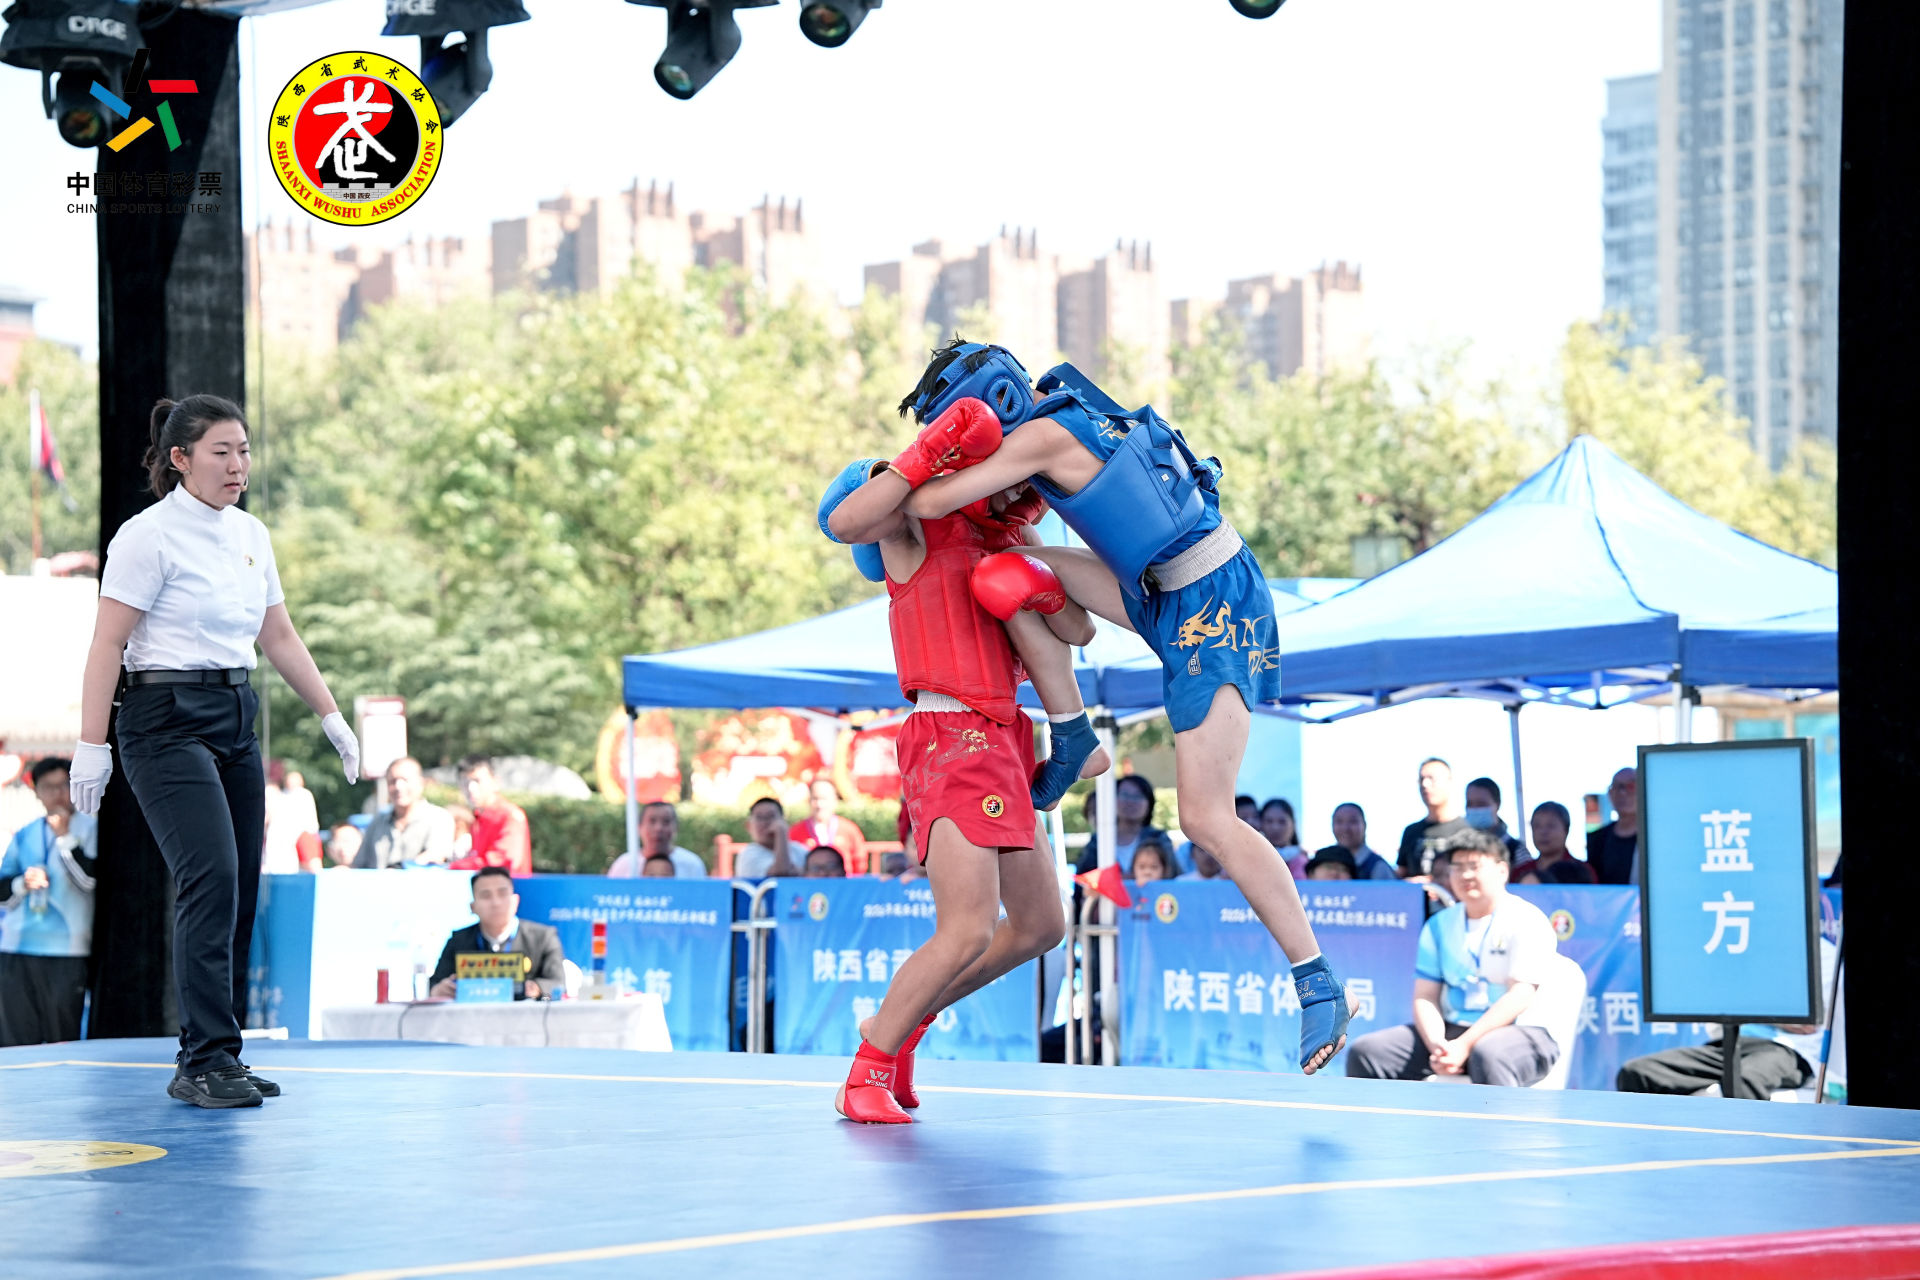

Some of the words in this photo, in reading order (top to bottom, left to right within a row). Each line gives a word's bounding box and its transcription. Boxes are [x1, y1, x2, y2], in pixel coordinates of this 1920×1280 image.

[1700, 809, 1754, 954] 蓝方
[1163, 968, 1377, 1021] 陕西省体局
